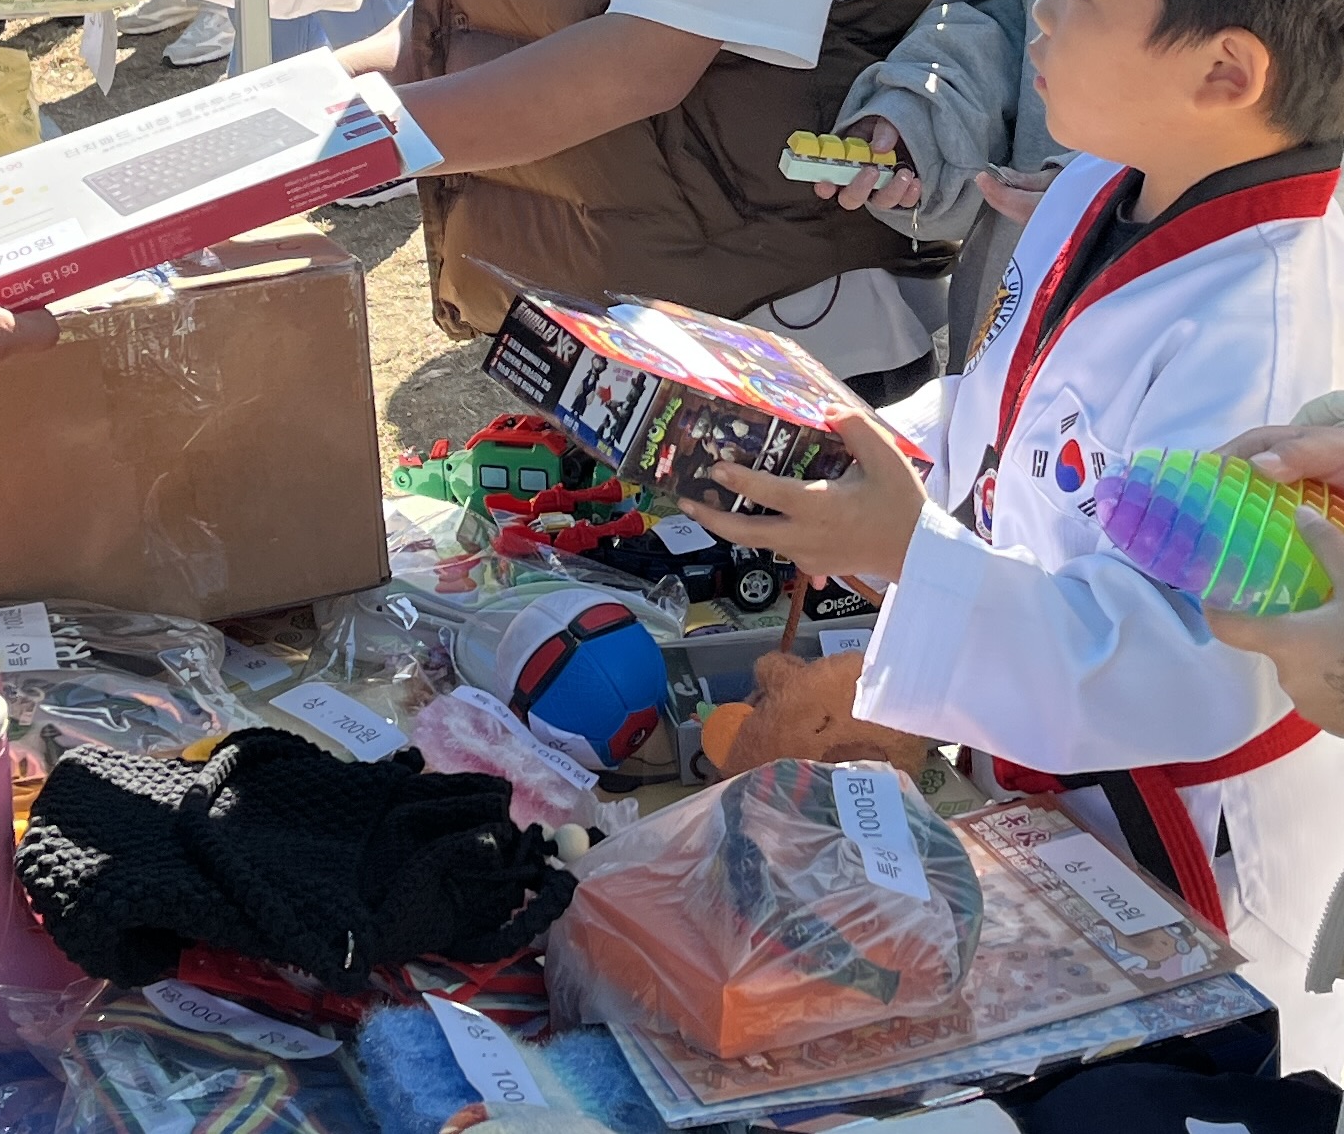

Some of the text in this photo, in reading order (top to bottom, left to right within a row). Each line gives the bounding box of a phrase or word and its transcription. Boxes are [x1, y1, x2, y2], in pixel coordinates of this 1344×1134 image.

[0, 262, 80, 300] OBK-B190
[819, 592, 862, 614] DISCO
[303, 697, 327, 710] 상
[332, 715, 381, 744] 700원
[847, 777, 903, 879] 특상 1000원
[1064, 861, 1092, 874] 상
[1093, 885, 1146, 922] 700원
